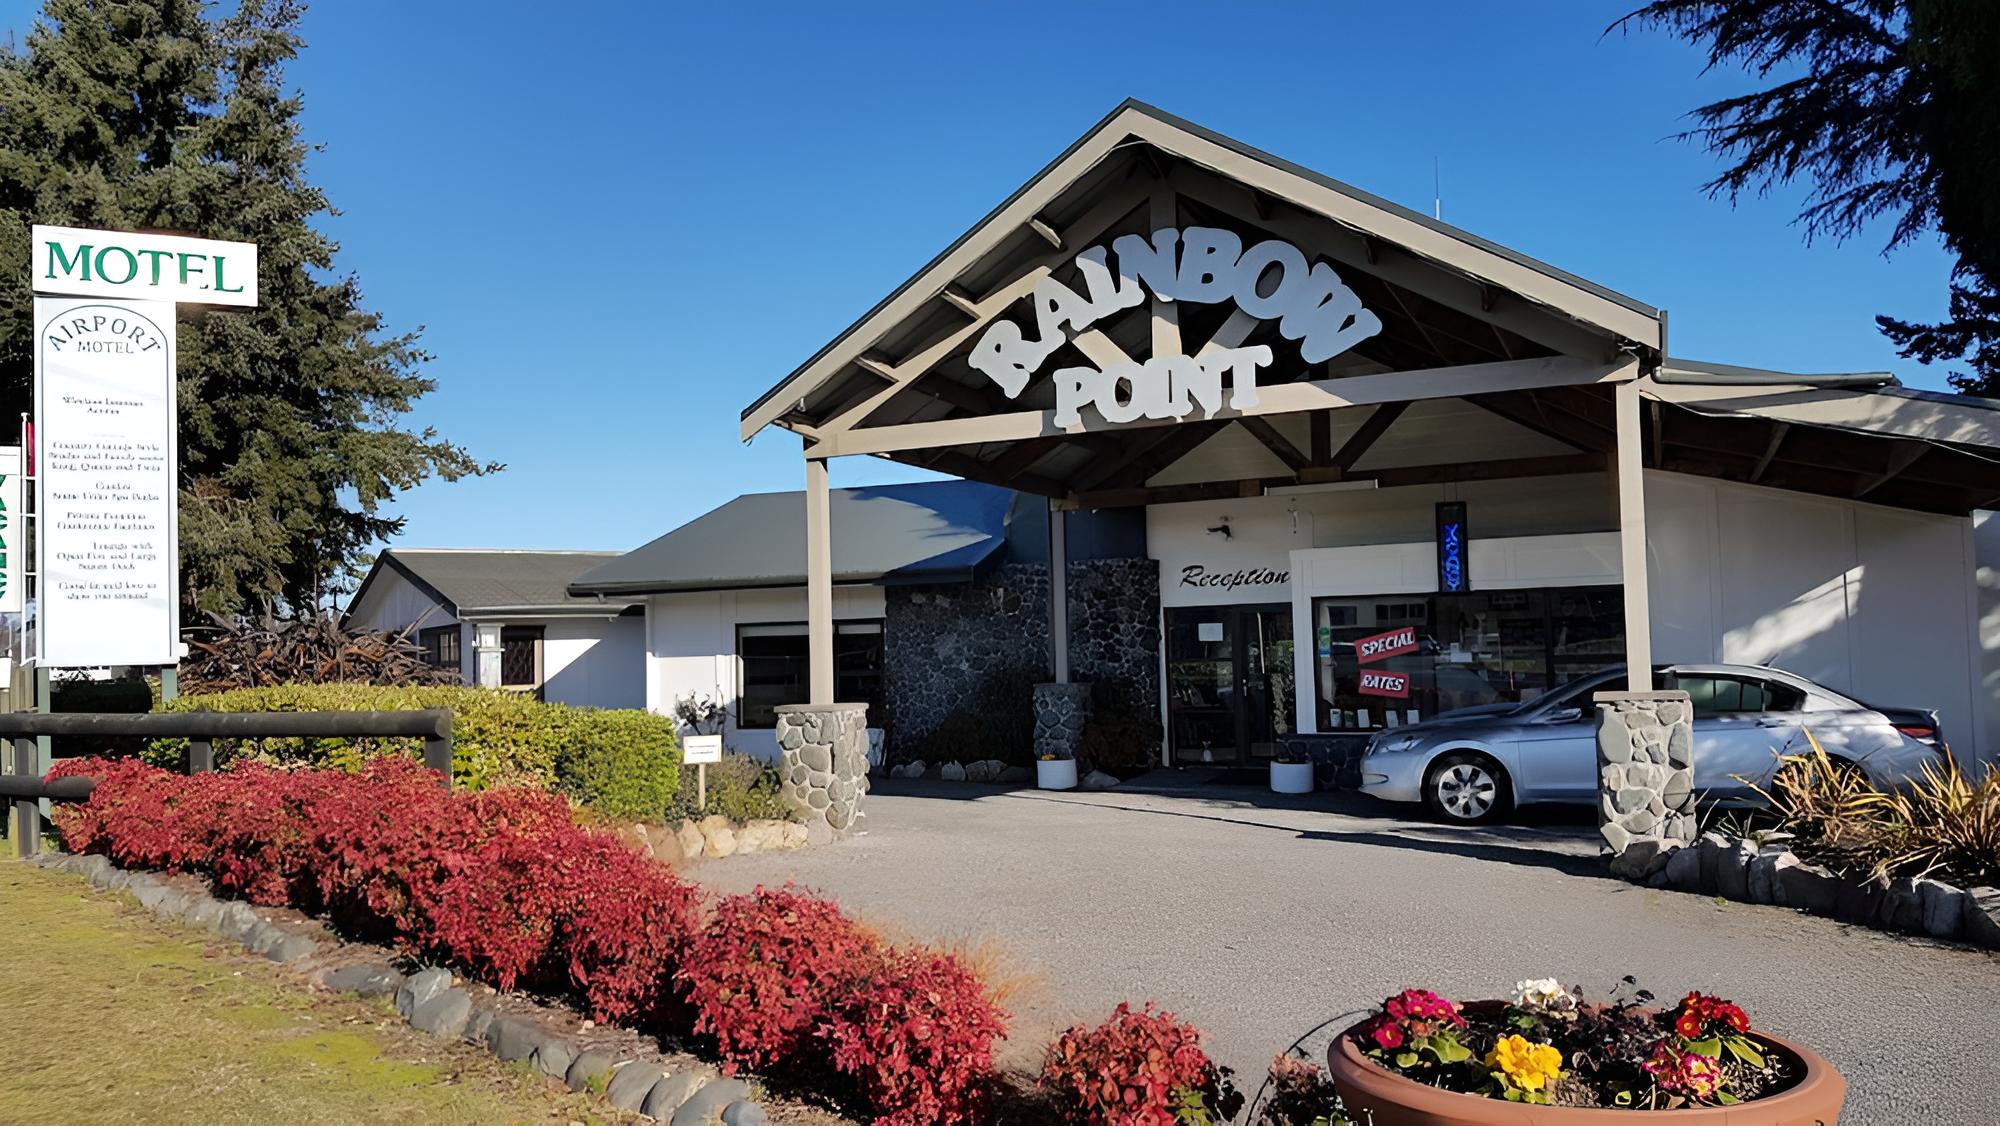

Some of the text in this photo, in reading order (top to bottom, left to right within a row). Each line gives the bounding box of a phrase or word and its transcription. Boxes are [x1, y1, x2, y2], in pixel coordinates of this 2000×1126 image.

[45, 241, 244, 293] MOTEL
[968, 226, 1382, 399] RAINBOW
[48, 315, 161, 352] AIRPORT
[77, 340, 134, 354] MOTEL
[1052, 344, 1273, 428] POINT
[1180, 565, 1291, 592] Reception
[1361, 632, 1416, 657] SPECIAL
[1361, 674, 1404, 691] RATES
